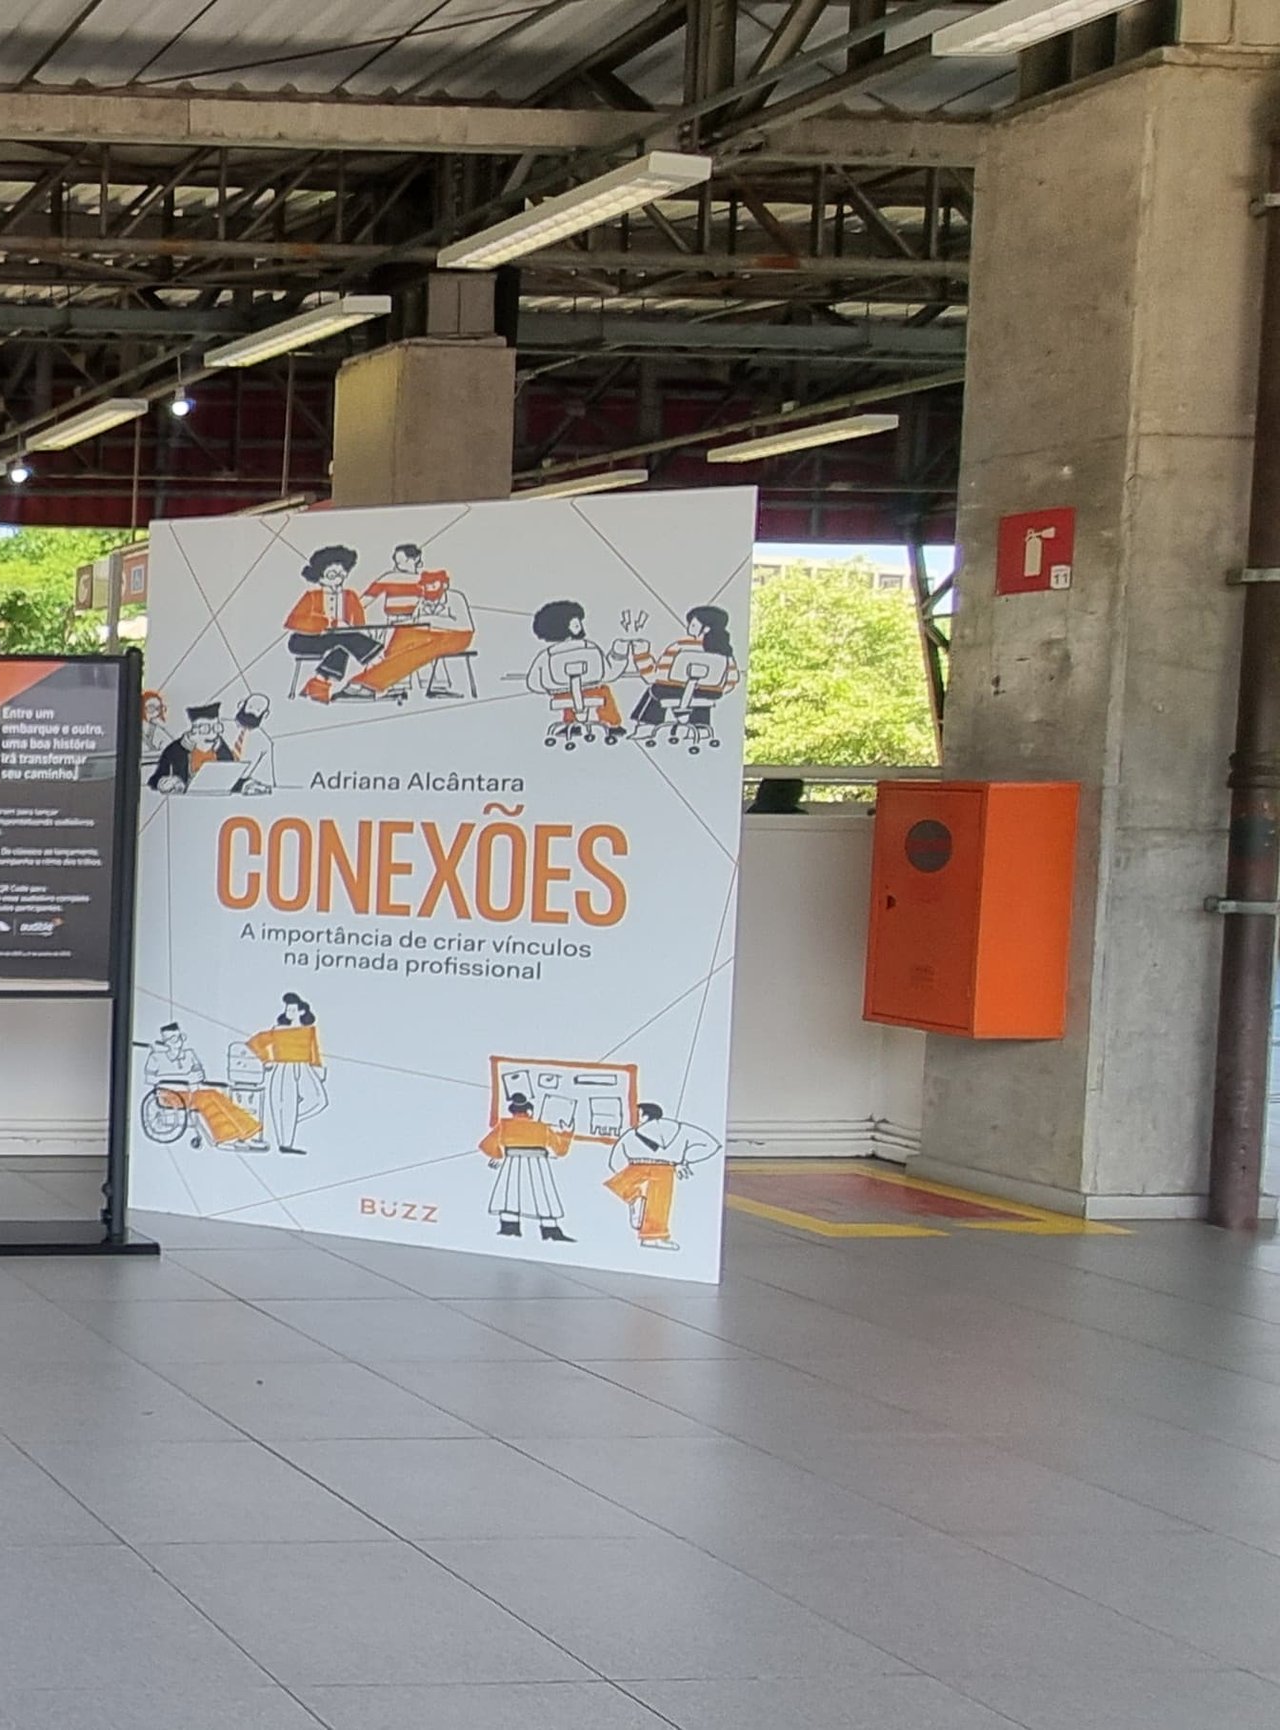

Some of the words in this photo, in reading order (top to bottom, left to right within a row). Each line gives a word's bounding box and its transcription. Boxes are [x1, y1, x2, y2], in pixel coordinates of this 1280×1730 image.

[2, 706, 33, 720] Entre
[35, 709, 55, 720] um
[1, 723, 60, 736] embarque
[62, 726, 69, 735] e
[71, 724, 105, 736] outro,
[1, 740, 27, 749] uma
[29, 738, 51, 749] boa
[52, 738, 96, 750] história
[1, 752, 17, 764] irá
[19, 752, 88, 765] transformar
[1, 769, 22, 779] seu
[310, 771, 400, 791] Adriana
[407, 772, 525, 793] Alcântara
[215, 802, 629, 928] CONEXÕES
[240, 923, 255, 940] A
[261, 925, 392, 948] importância
[399, 930, 427, 949] de
[433, 935, 486, 953] criar
[493, 935, 592, 958] vínculos
[283, 951, 309, 966] na
[314, 949, 398, 972] jornada
[405, 958, 542, 980] profissional
